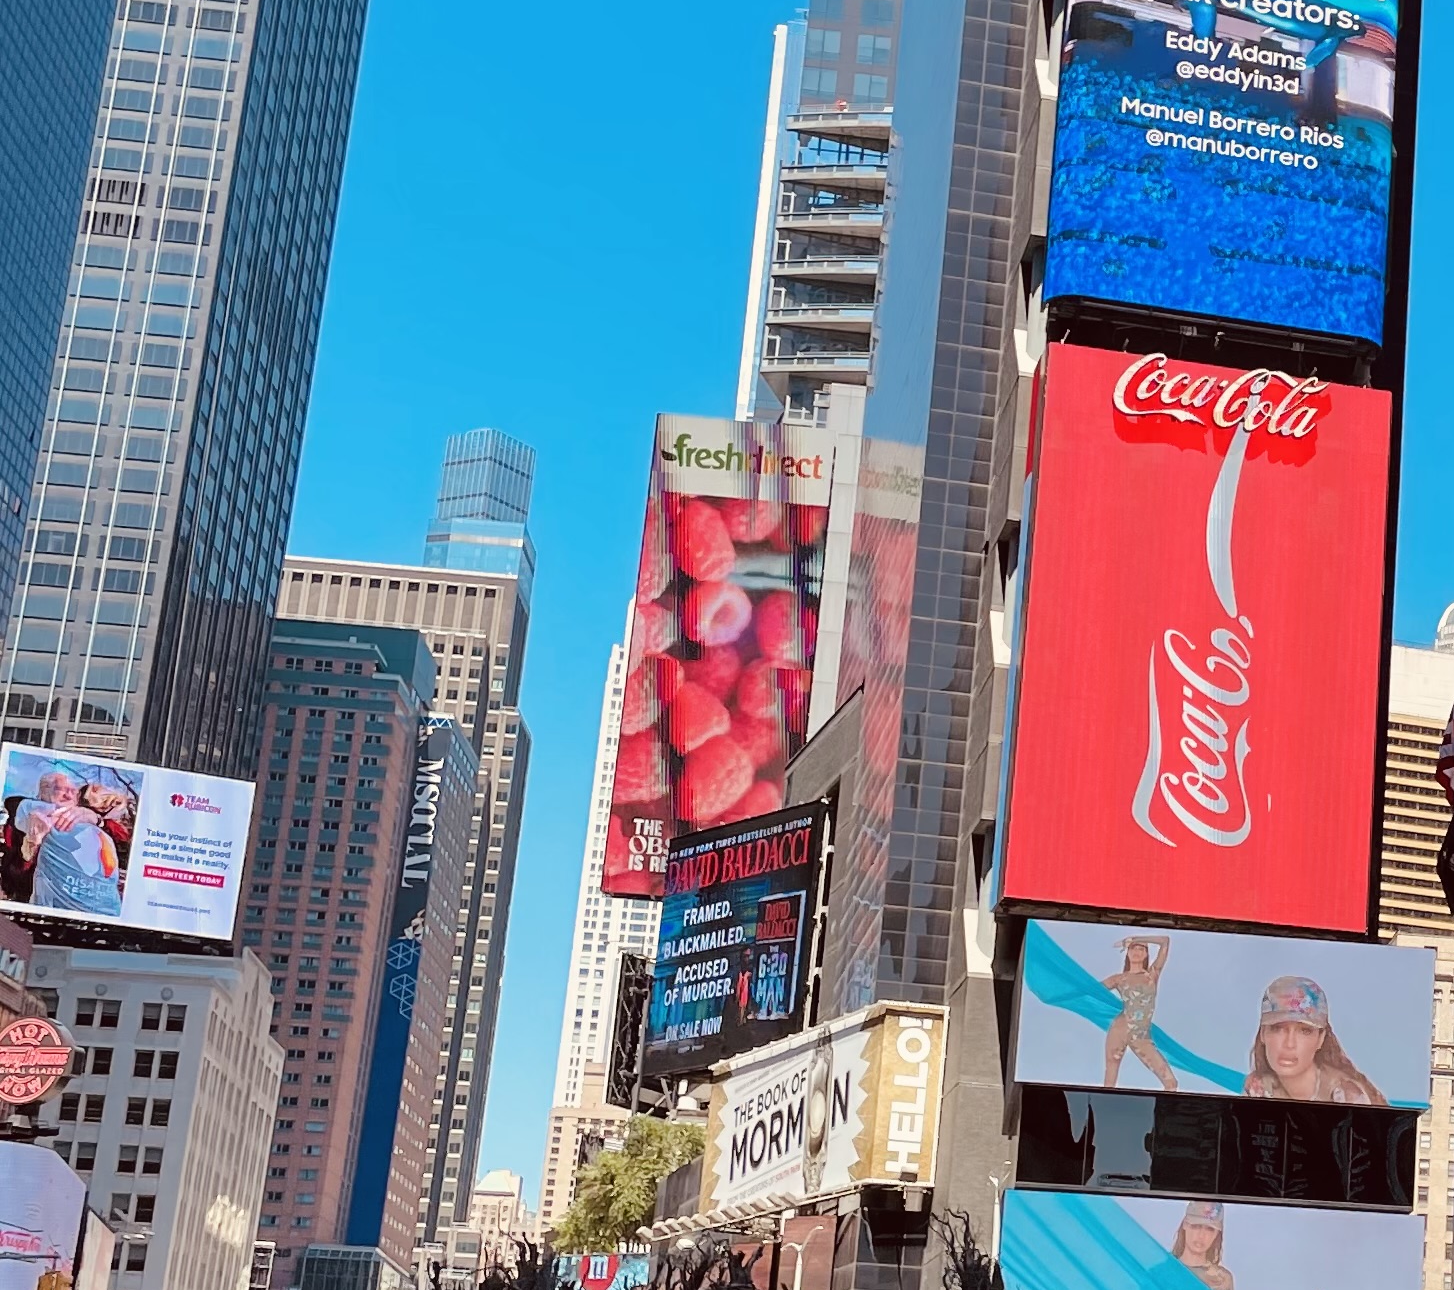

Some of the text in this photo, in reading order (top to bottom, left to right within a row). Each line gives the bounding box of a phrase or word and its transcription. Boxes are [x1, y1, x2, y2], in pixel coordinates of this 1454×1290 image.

[1165, 30, 1307, 71] Eddy Adams
[1176, 61, 1299, 95] @eddyin3d
[1121, 96, 1344, 149] Manuel Borrero Rios
[1145, 128, 1318, 170] @manuborrero
[146, 828, 167, 838] Take
[168, 833, 188, 842] your
[633, 818, 664, 837] THE
[143, 840, 169, 850] doing
[208, 850, 231, 859] good
[664, 827, 811, 896] DAVID BALDACCI
[679, 847, 695, 858] NEW
[696, 841, 715, 854] YORK
[147, 868, 222, 885] VOLUNTEER TODAY
[628, 856, 644, 872] IS
[683, 901, 733, 927] FRAMED.
[663, 927, 747, 961] BLACKMAILED.
[674, 957, 729, 985] ACCUSED
[664, 978, 735, 1007] OF MURDER.
[9, 1024, 50, 1043] HOT
[0, 1076, 42, 1097] NOW
[734, 1098, 755, 1127] THE
[756, 1077, 789, 1115] BOOK
[791, 1067, 807, 1095] OF
[885, 1015, 933, 1173] HELLO!
